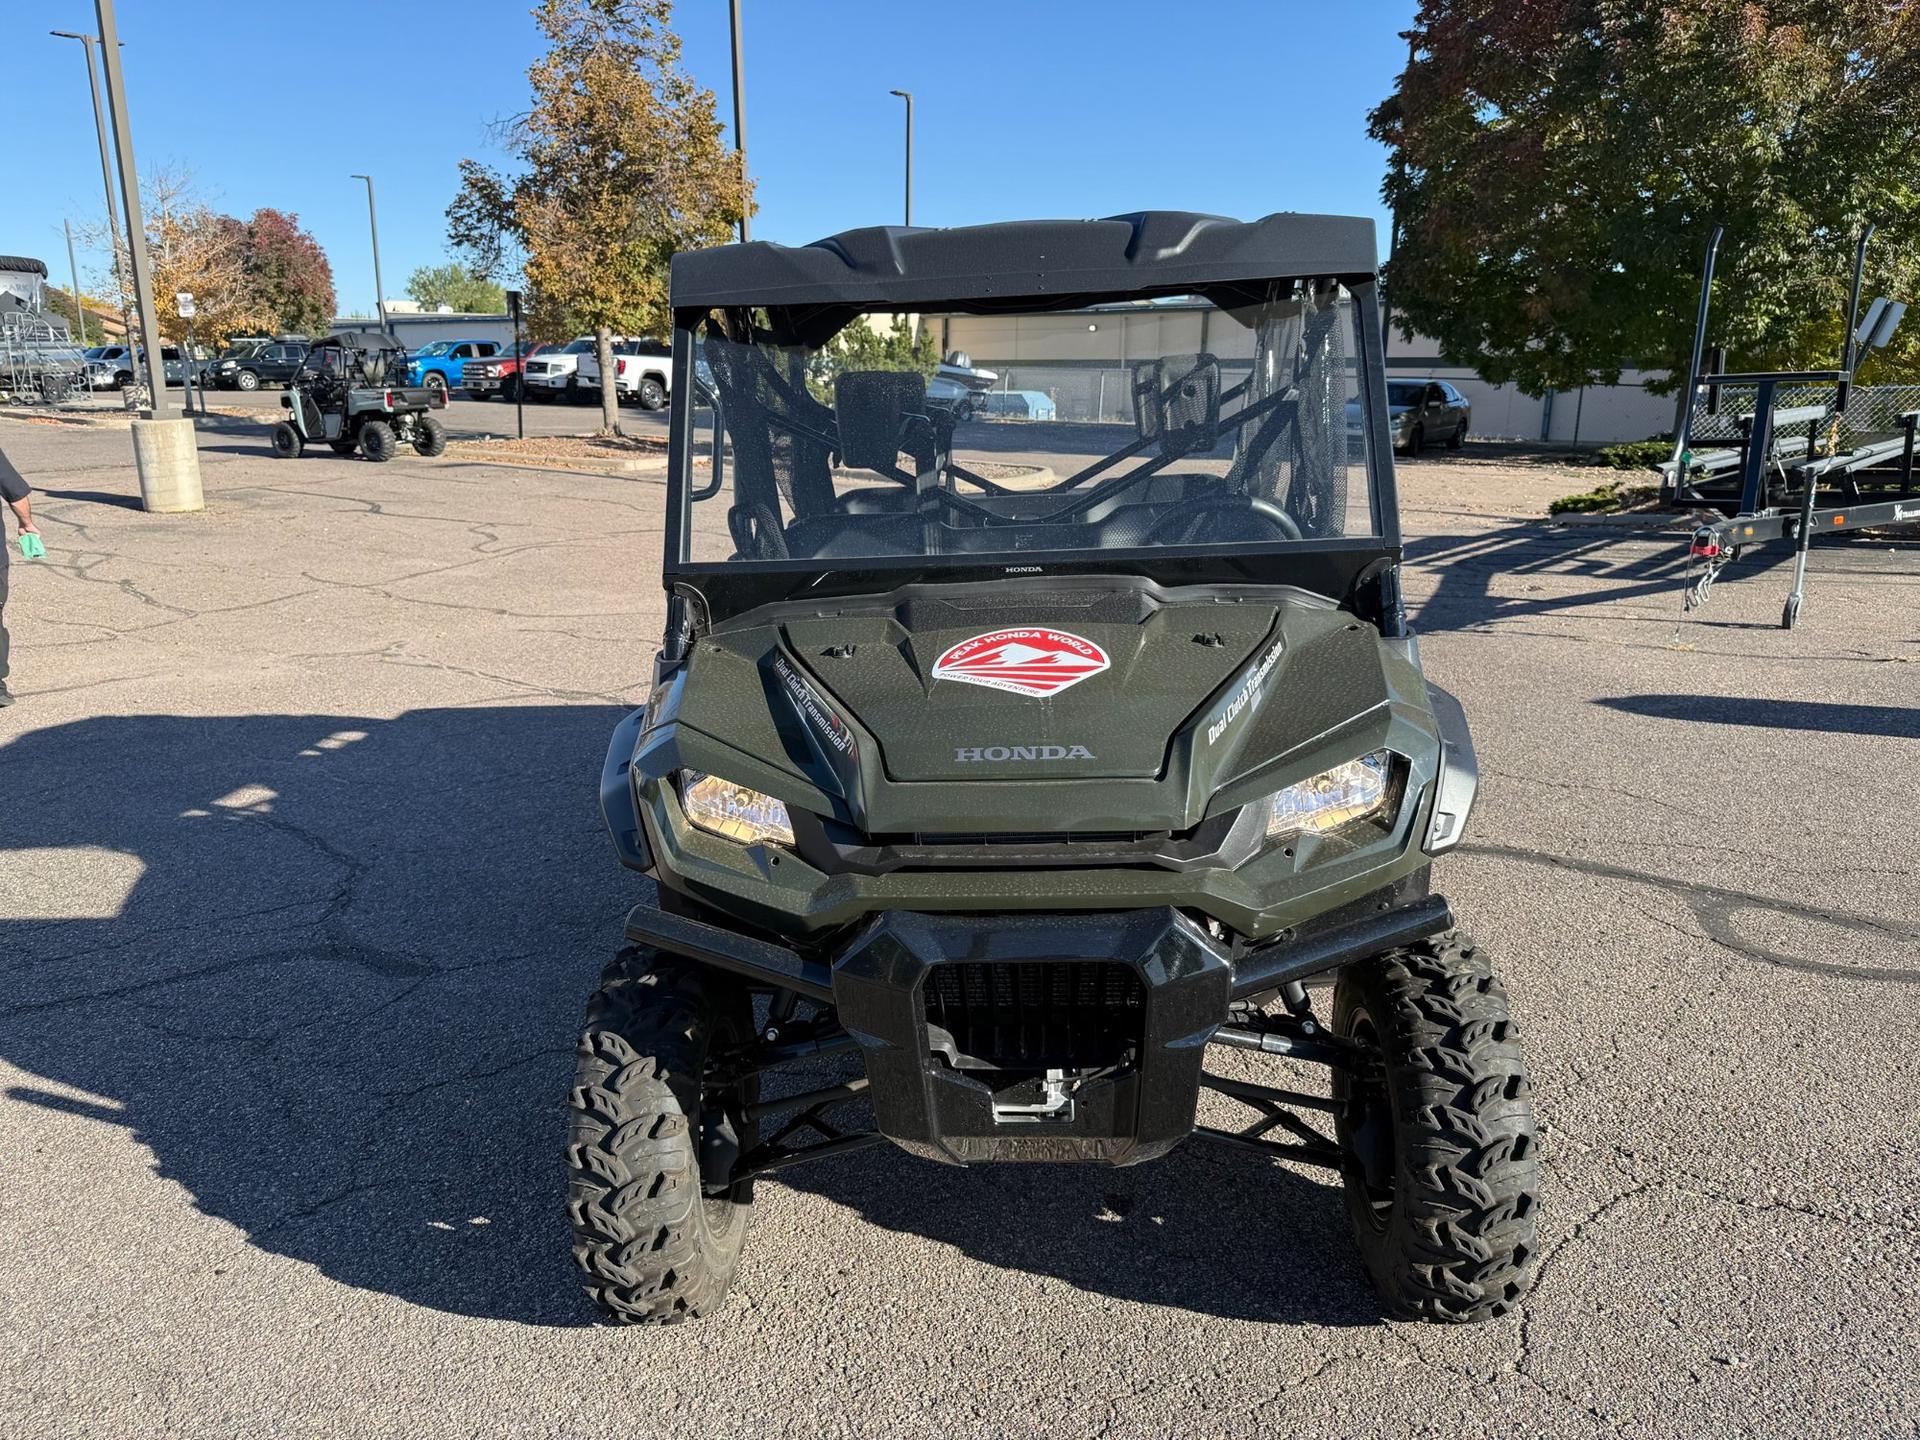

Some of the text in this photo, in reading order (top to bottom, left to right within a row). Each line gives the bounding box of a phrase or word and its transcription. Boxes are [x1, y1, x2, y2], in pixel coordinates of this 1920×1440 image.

[949, 632, 1093, 659] PEAK HONDA WORLD
[991, 681, 1041, 695] ADVENTURE
[1208, 641, 1283, 746] Dual Clutch Transmission
[776, 658, 846, 751] Dual Clutch Transmission
[954, 745, 1096, 762] HONDA
